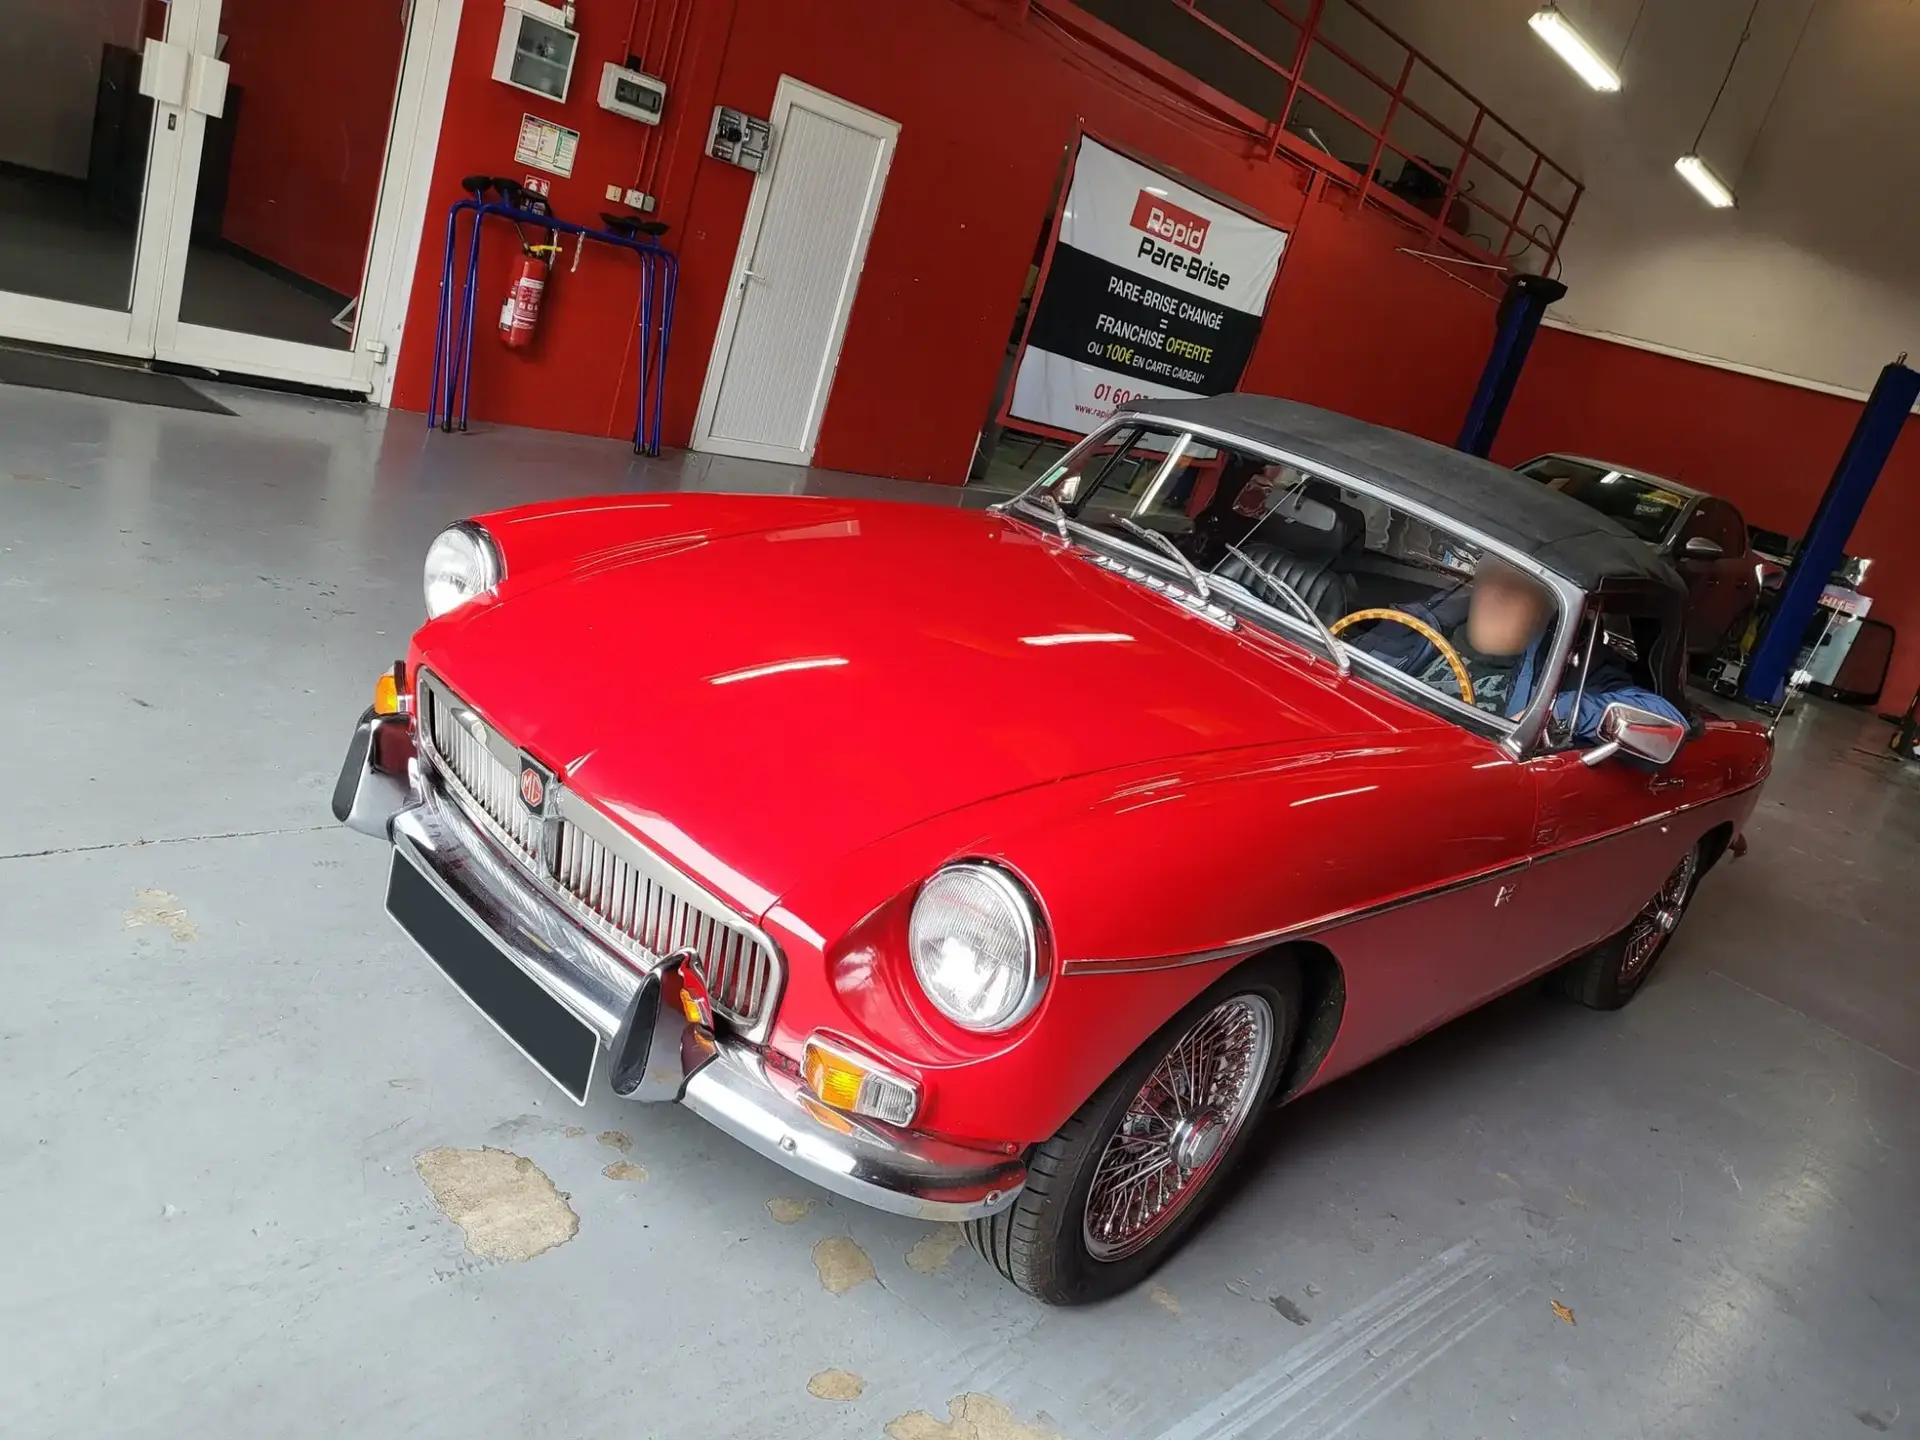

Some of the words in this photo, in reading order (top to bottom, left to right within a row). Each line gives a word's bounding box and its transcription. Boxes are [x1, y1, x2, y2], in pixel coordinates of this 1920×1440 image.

[1146, 207, 1204, 249] Rapid
[1137, 236, 1230, 290] Pare-Brise
[1107, 276, 1178, 316] PARE-BRISE
[1178, 302, 1224, 331] CHANGÉ
[1087, 341, 1104, 356] OU
[1105, 343, 1135, 365] 100€
[1132, 354, 1146, 369] EN
[1145, 358, 1172, 376] CARTE
[1095, 313, 1166, 350] FRANCHISE
[1165, 336, 1213, 364] OFFERTE
[1094, 383, 1112, 401] 01
[1112, 388, 1130, 404] 60
[522, 772, 541, 803] MG
